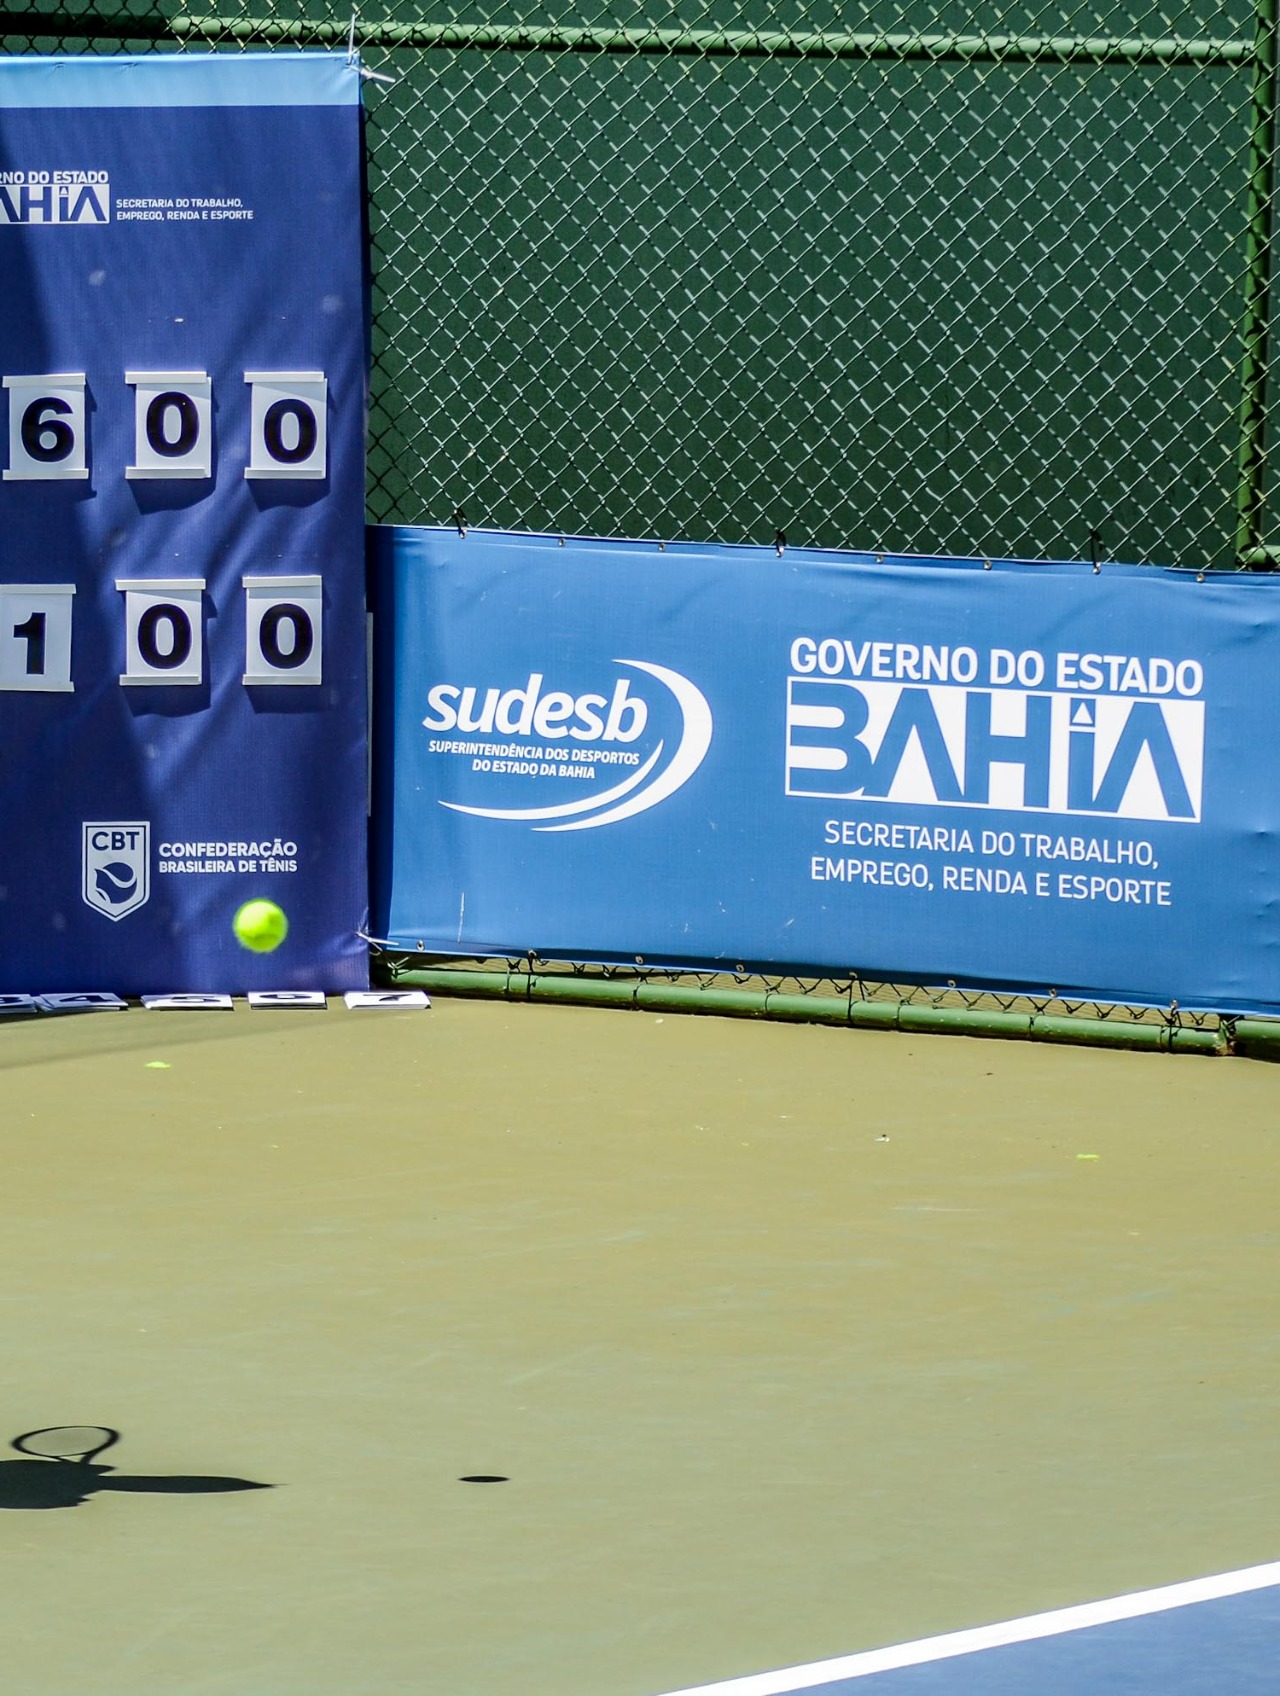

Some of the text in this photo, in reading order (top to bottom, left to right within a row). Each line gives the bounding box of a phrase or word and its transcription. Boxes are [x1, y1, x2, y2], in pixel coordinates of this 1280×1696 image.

[28, 171, 50, 184] DO
[53, 171, 108, 184] ESTADO
[116, 198, 243, 209] SECRETARIA DO TRABALHO,
[116, 210, 254, 222] EMPREGO, RENDA E ESPORTE
[21, 391, 318, 464] 6 0 0
[13, 602, 314, 675] 1 0 0
[789, 636, 1203, 696] GOVERNO DO ESTADO
[422, 673, 648, 743] sudesb
[428, 740, 640, 766] SUPERINTENDÊNCIA DOS DESPORTOS
[472, 759, 595, 779] DO ESTADO DA BAHIA
[91, 830, 140, 851] CBT
[158, 838, 298, 859] CONFEDERAÇÃO
[824, 820, 1160, 870] SECRETARIA DO TRABALHO,
[159, 857, 298, 873] BRASILEIRA DE TÊNIS
[811, 857, 1172, 906] EMPREGO, RENDA E ESPORTE
